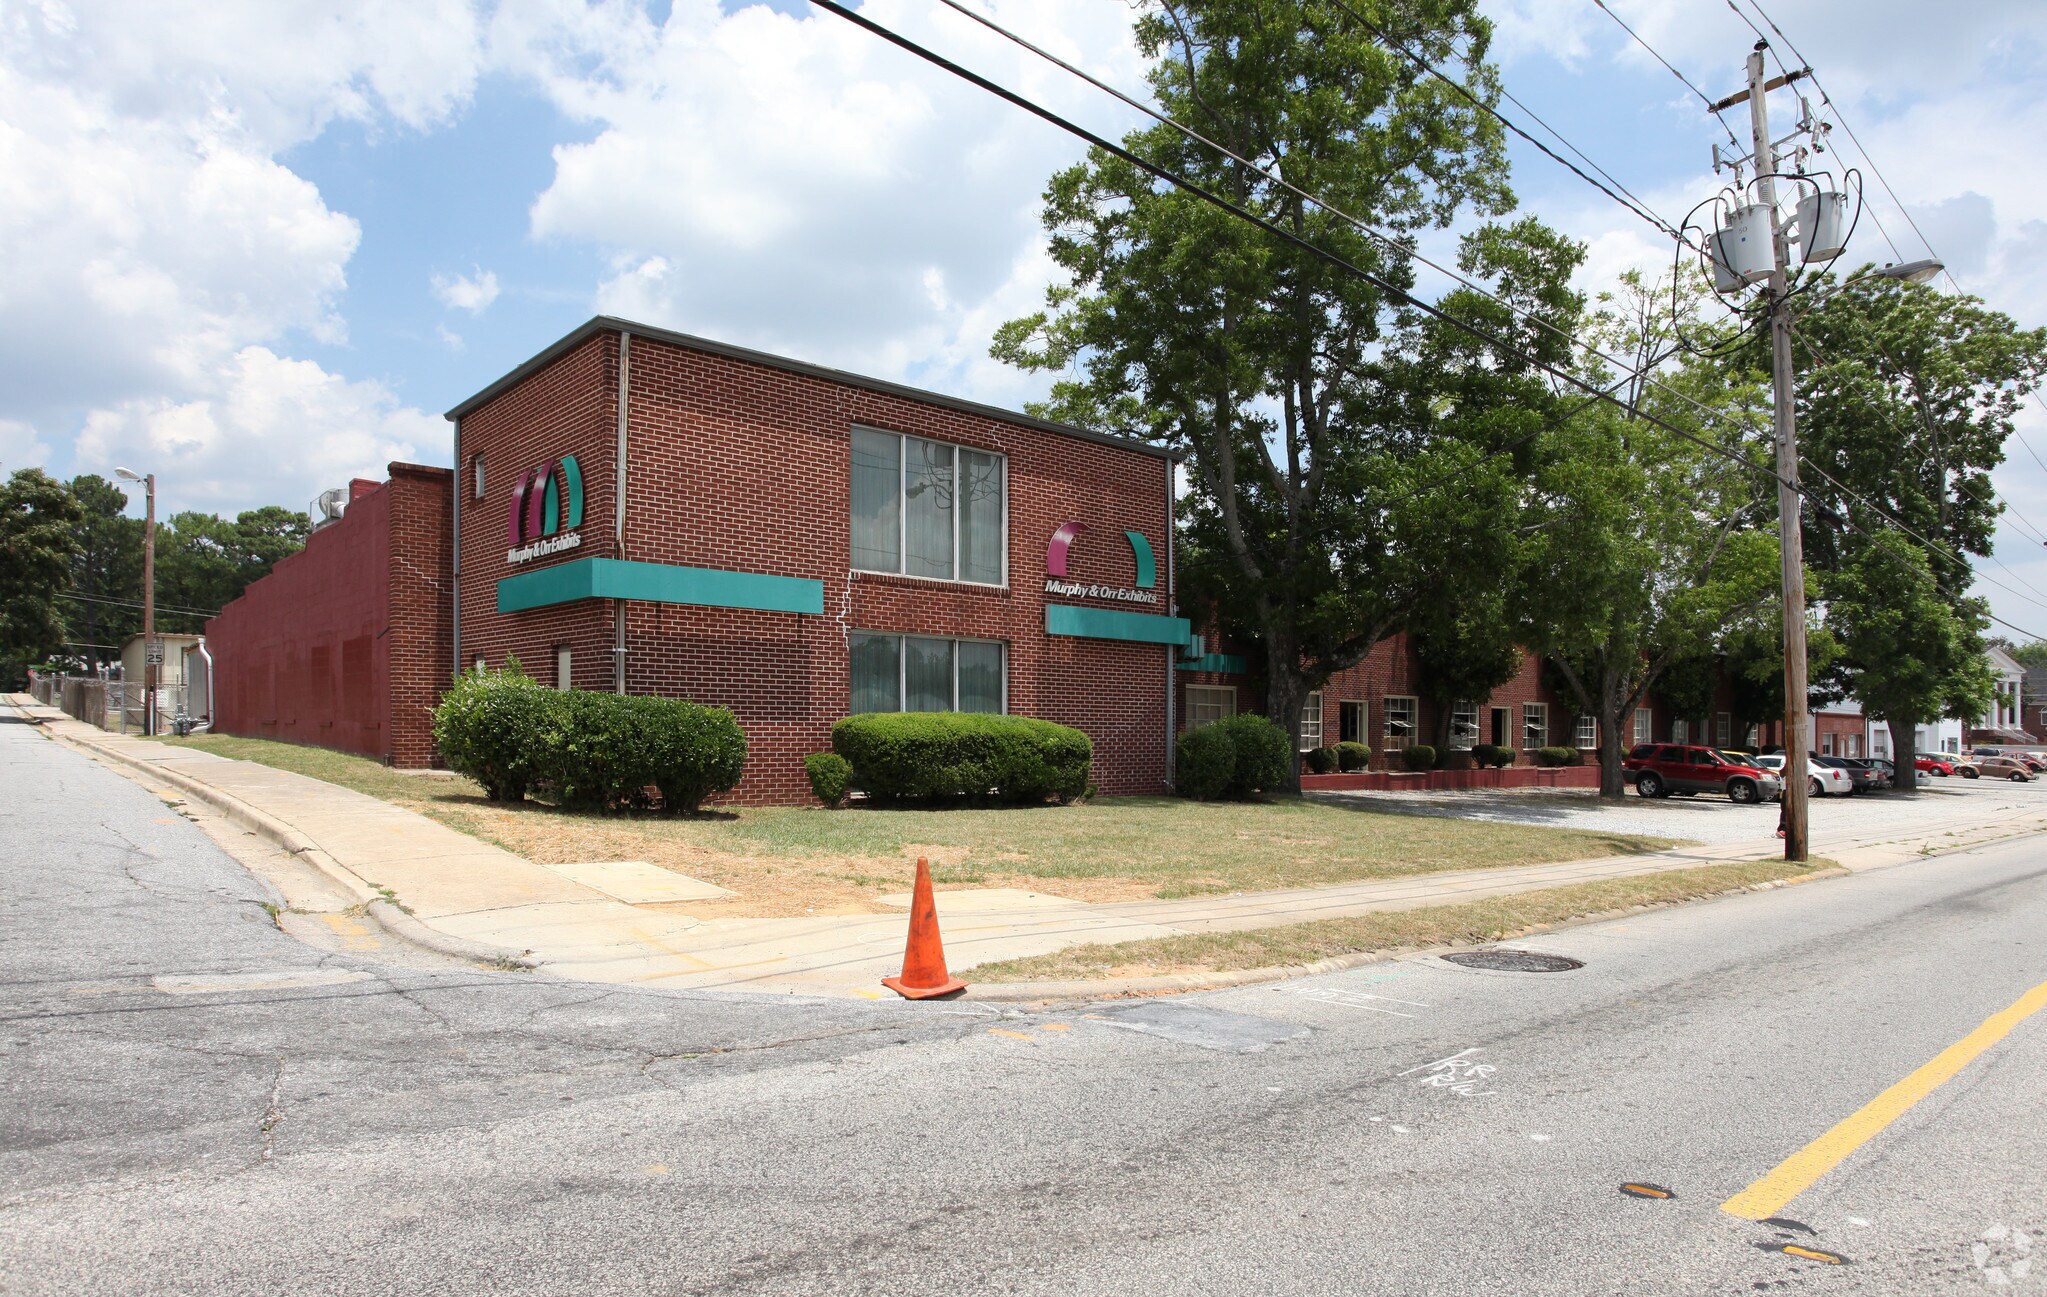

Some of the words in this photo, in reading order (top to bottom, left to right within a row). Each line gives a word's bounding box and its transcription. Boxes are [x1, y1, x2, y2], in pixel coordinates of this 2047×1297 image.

[508, 545, 533, 563] Murphy
[533, 542, 540, 557] &
[540, 540, 552, 556] Orr
[551, 532, 581, 552] Exhibits
[1045, 580, 1088, 598] Murphy
[1089, 585, 1098, 597] &
[1100, 586, 1119, 599] Orr
[1118, 588, 1158, 603] Exhibits
[148, 654, 163, 663] 25
